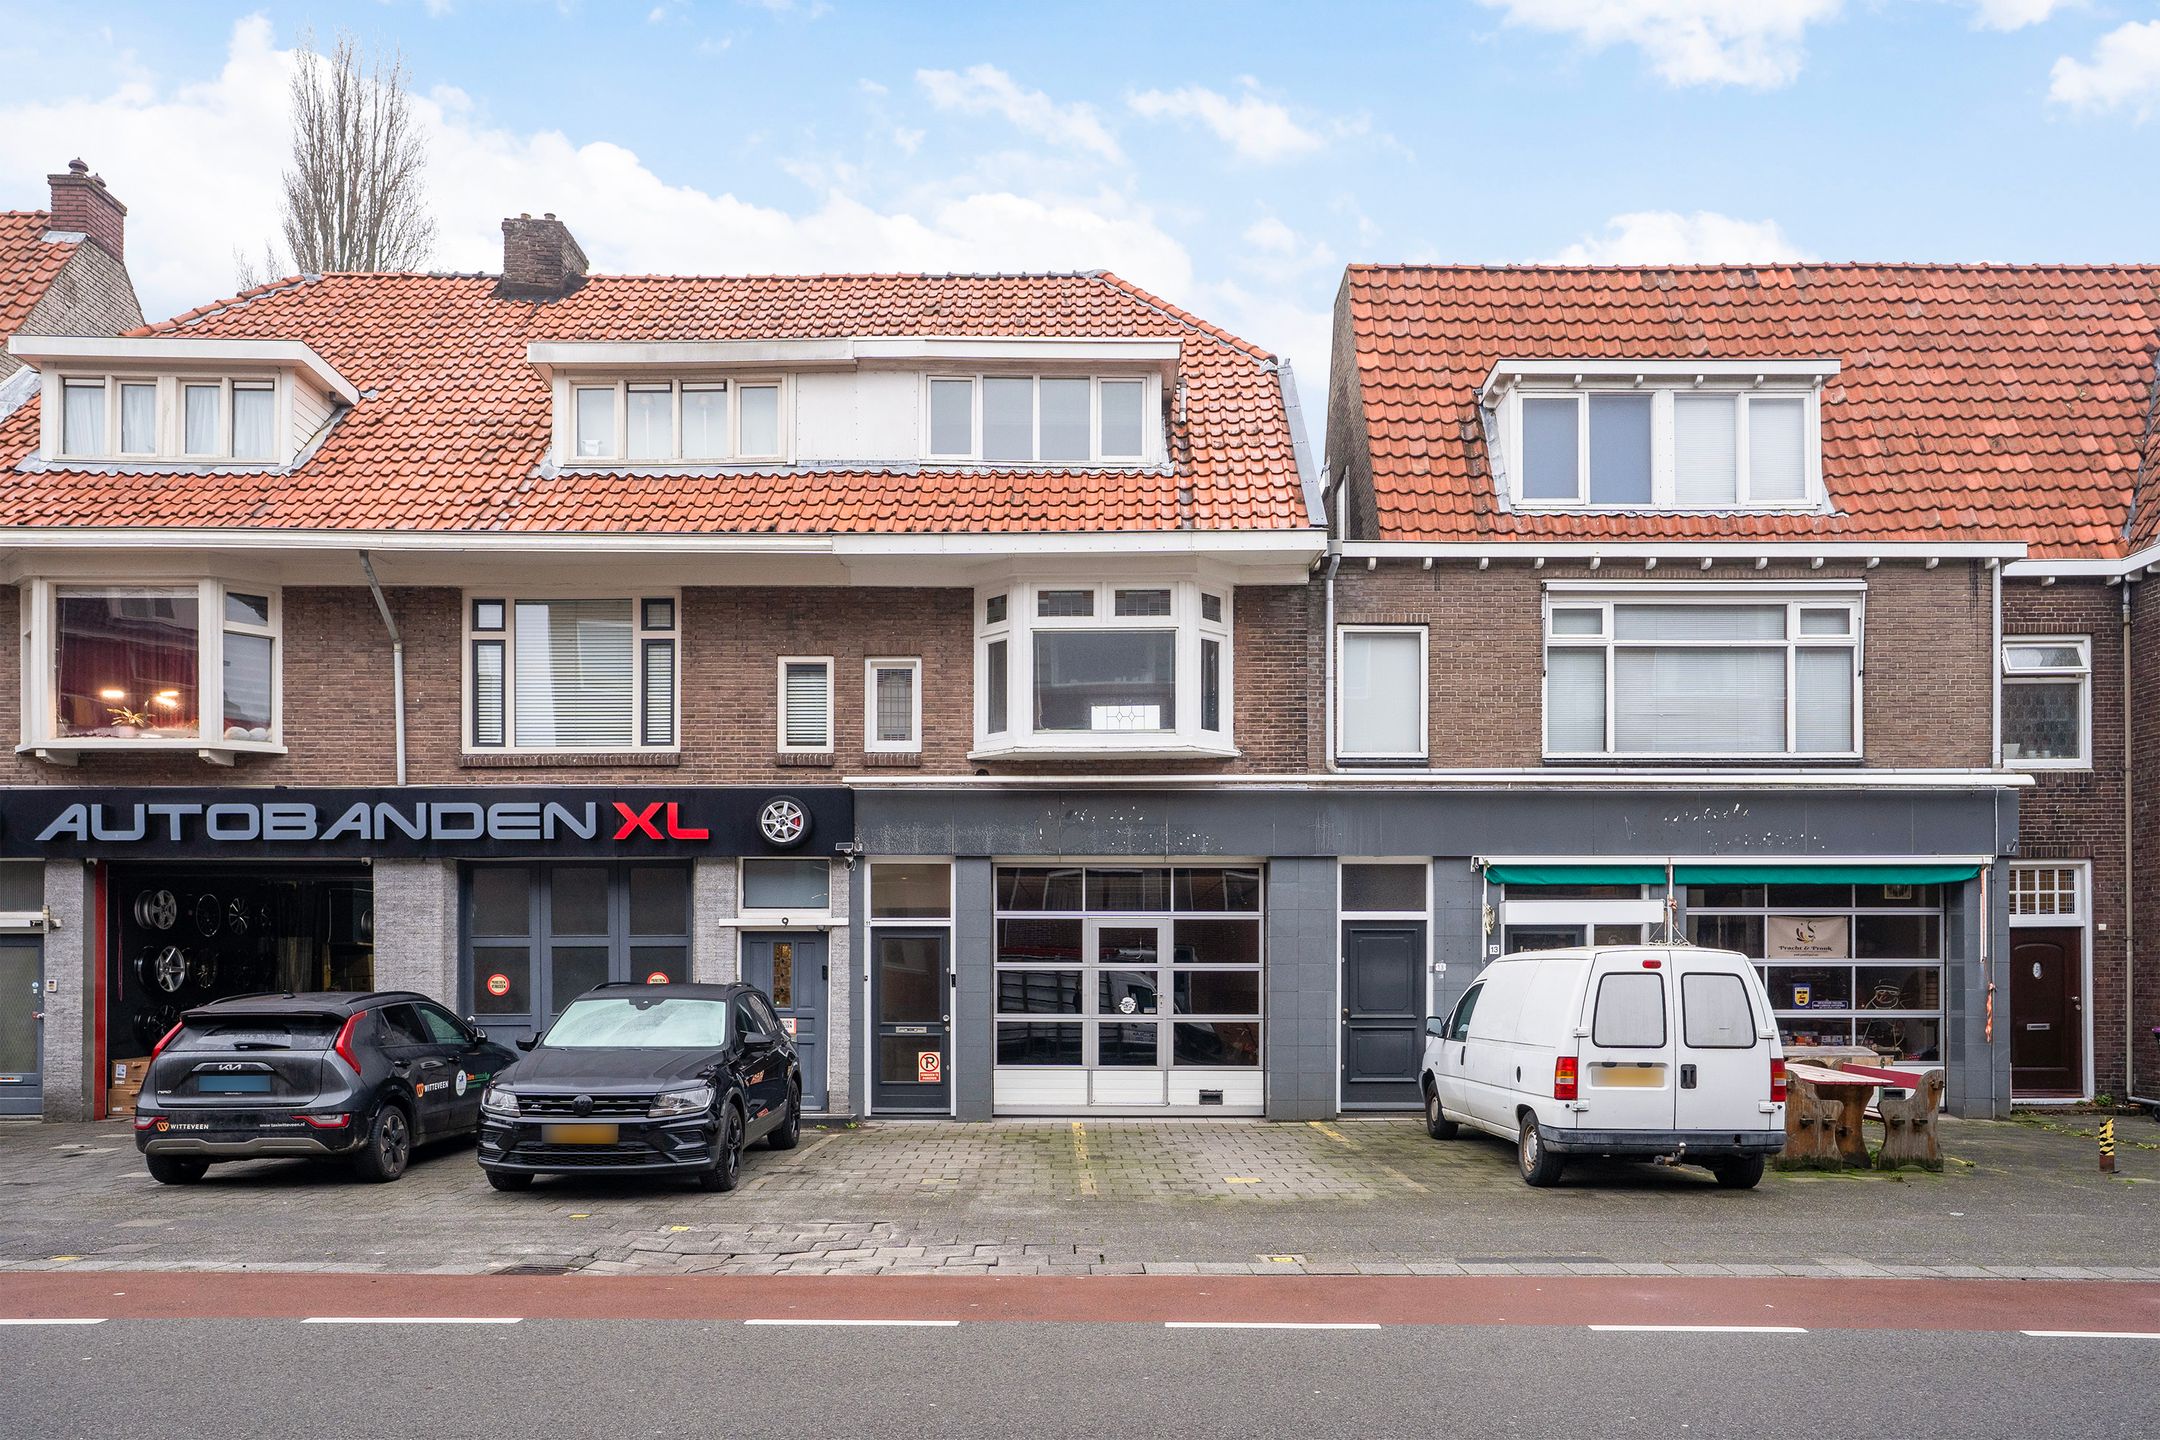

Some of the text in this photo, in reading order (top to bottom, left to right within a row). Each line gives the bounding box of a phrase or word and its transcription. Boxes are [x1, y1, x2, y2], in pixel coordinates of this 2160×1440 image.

[34, 802, 710, 841] AUTOBANDEN XL
[781, 917, 789, 928] 9
